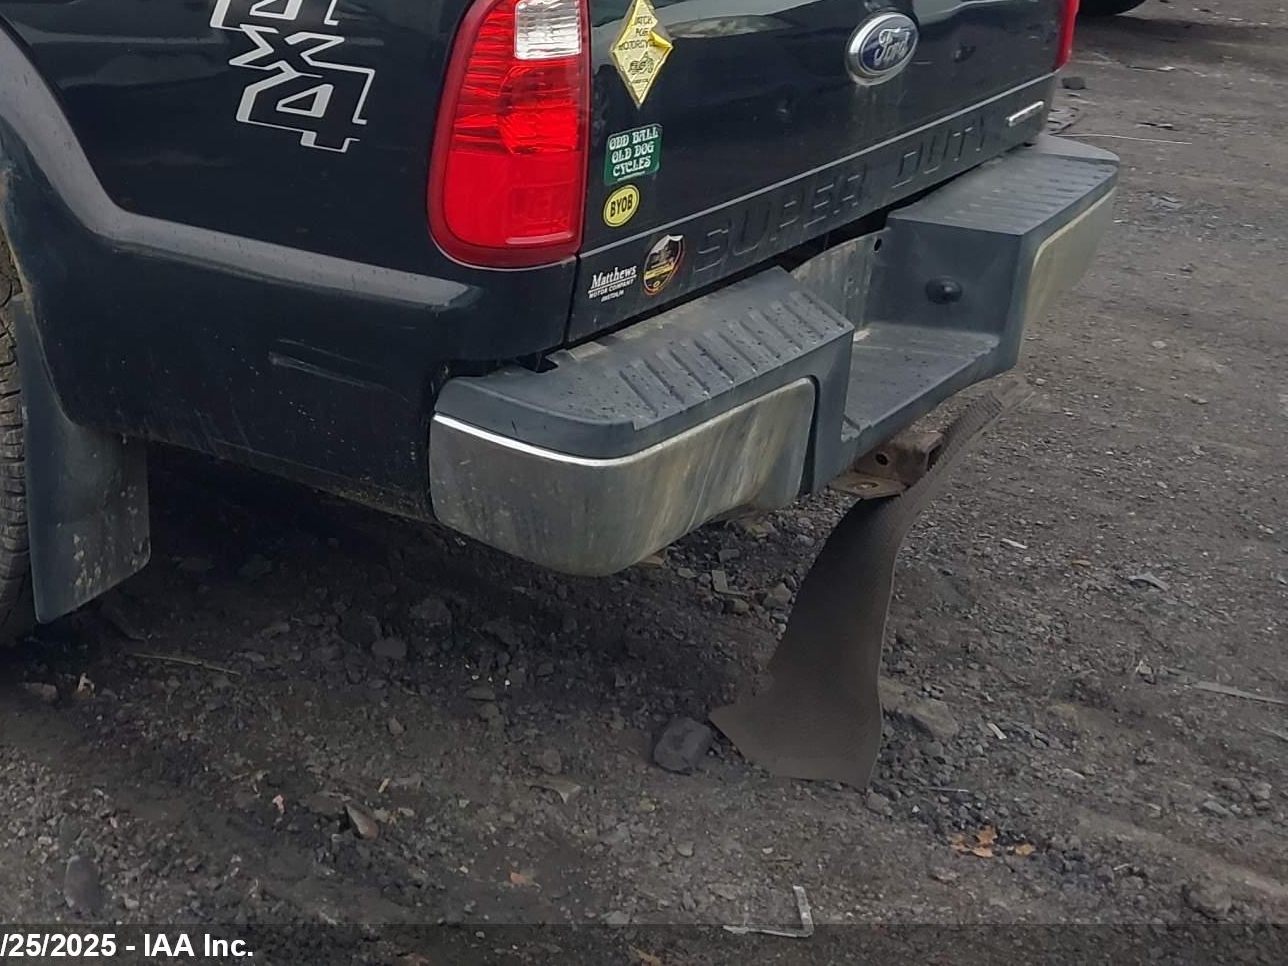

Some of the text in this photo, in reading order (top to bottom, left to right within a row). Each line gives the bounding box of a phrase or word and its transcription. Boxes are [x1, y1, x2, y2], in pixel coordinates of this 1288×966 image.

[873, 27, 912, 67] Ford
[609, 126, 659, 151] ODD BALL
[611, 140, 655, 164] OLD DOG
[612, 155, 652, 177] CYCLES
[610, 193, 634, 218] BYOB
[590, 265, 638, 290] Matthews
